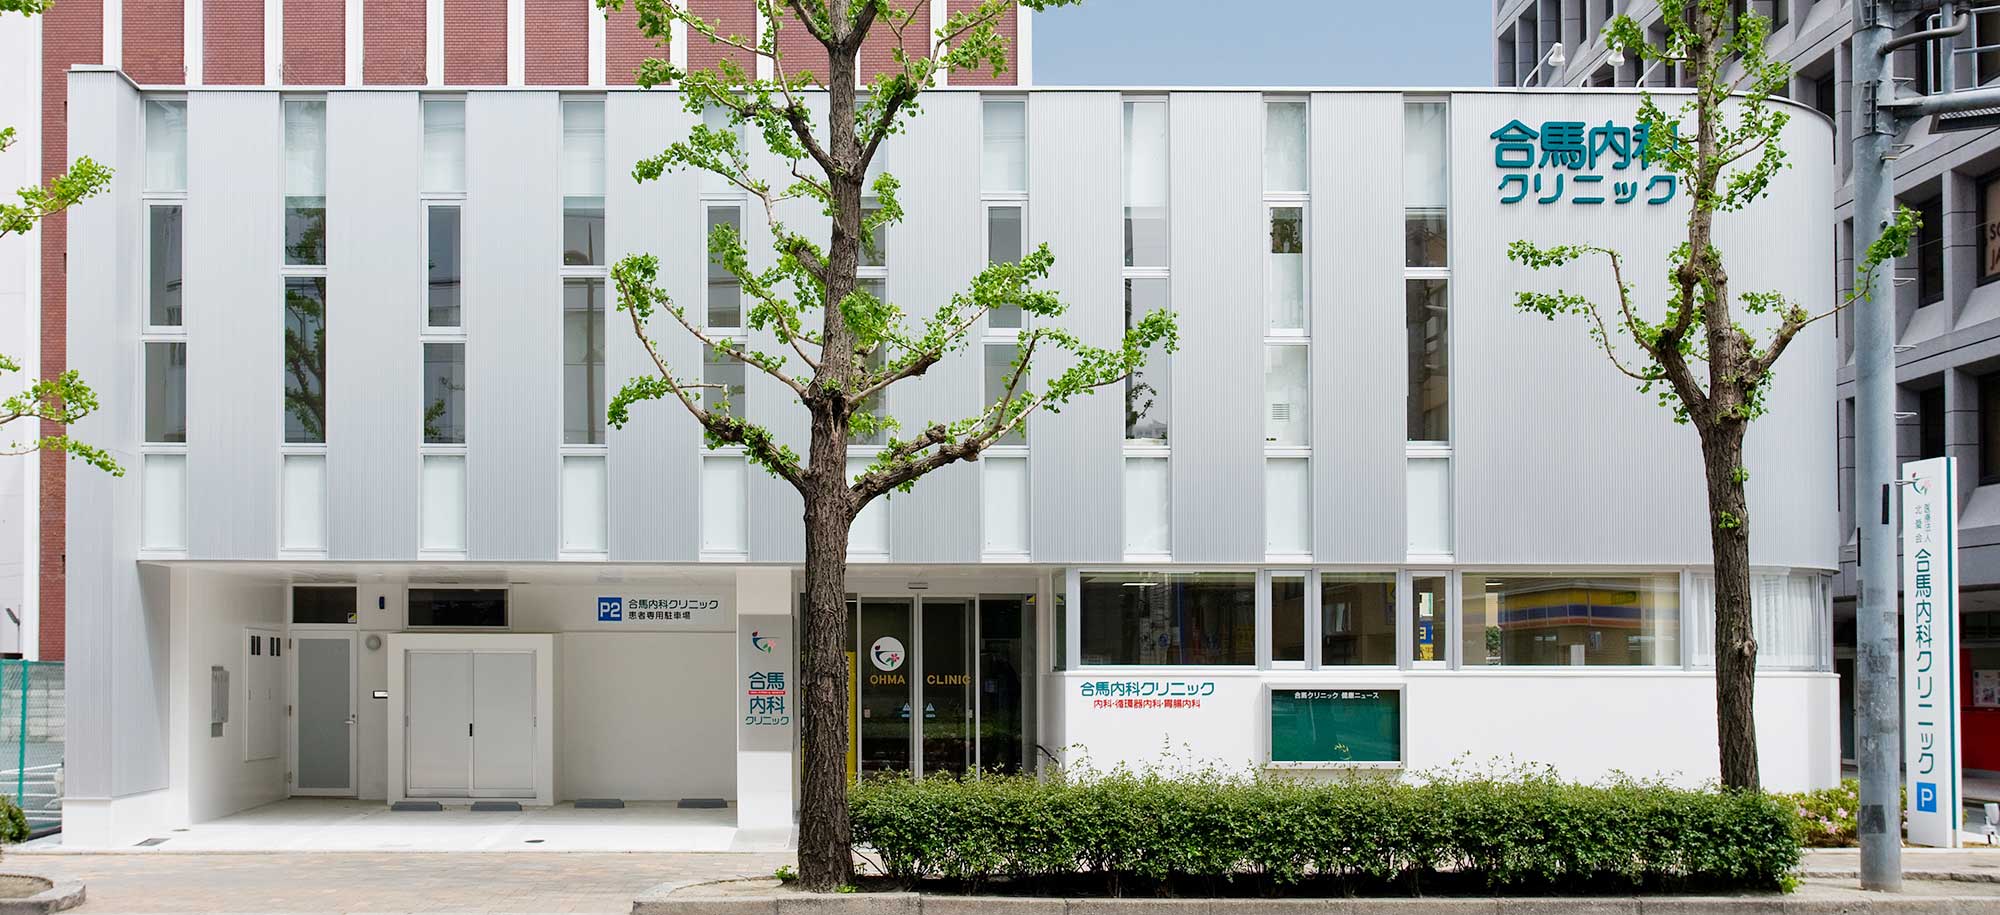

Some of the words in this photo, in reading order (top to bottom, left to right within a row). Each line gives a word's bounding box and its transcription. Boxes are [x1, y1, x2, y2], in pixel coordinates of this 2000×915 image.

[1498, 173, 1676, 204] クリニック
[600, 602, 620, 617] P2
[628, 599, 718, 609] 合馬内科クリニック
[628, 611, 690, 620] 患者専用駐車場
[1915, 548, 1934, 775] 合馬内科クリニック
[748, 671, 785, 690] 合馬
[870, 674, 906, 685] OHMA
[927, 674, 971, 685] CLINIC
[1080, 681, 1215, 697] 合馬内科クリニック
[749, 695, 785, 714] 内科
[745, 716, 789, 725] クリニック
[1921, 788, 1933, 807] P
